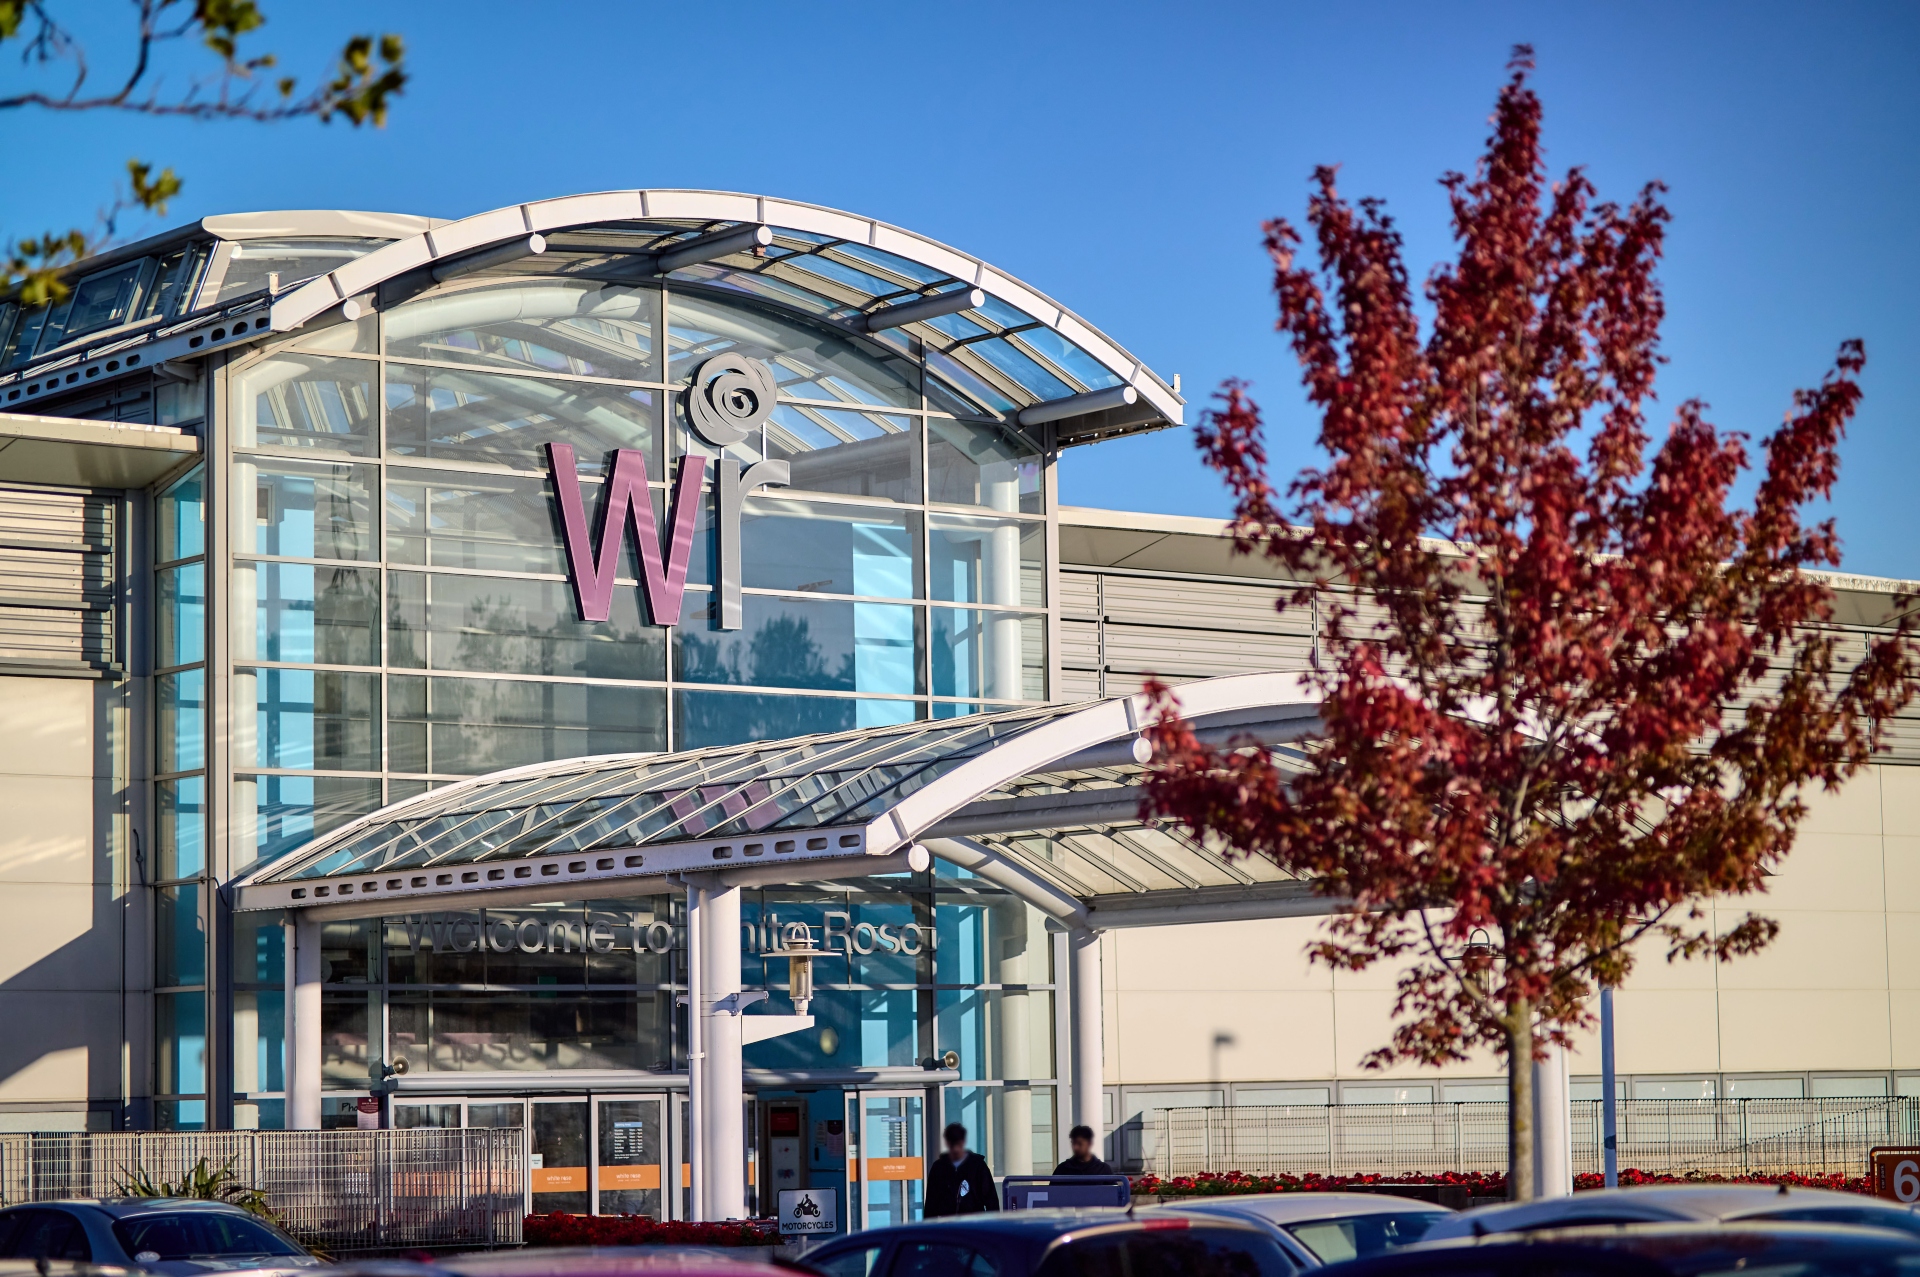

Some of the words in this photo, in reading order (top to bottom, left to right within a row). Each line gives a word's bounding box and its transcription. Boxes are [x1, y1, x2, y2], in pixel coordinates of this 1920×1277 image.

[404, 908, 616, 954] Welcome
[629, 912, 676, 954] to
[824, 911, 923, 956] Rose
[1894, 1160, 1920, 1203] 6
[781, 1221, 834, 1231] MOTORCYCLES
